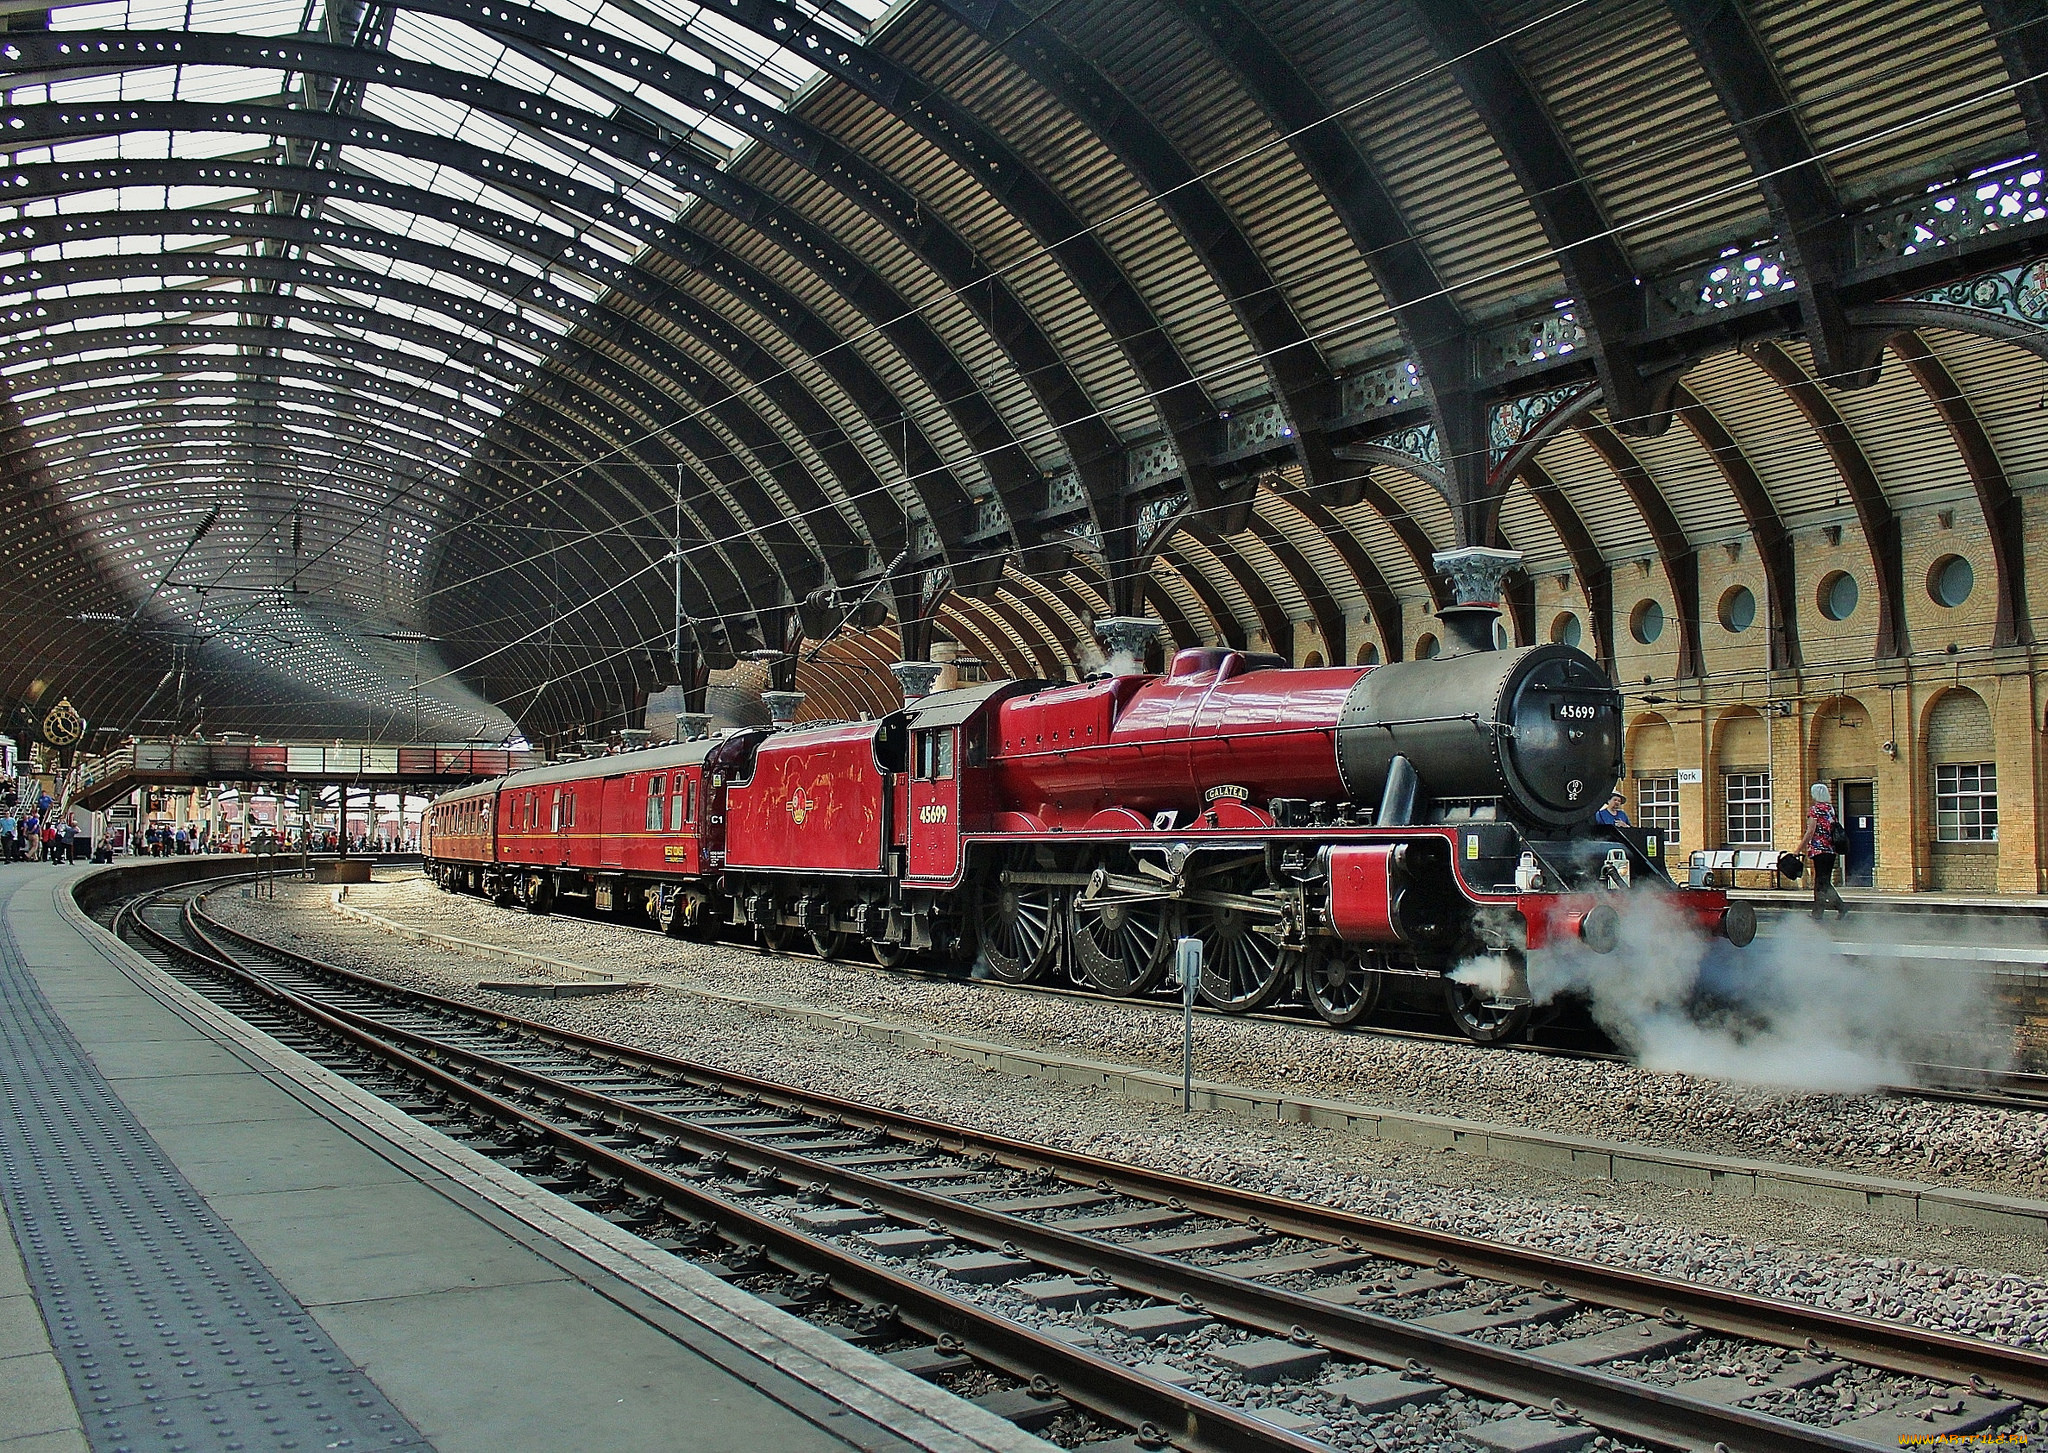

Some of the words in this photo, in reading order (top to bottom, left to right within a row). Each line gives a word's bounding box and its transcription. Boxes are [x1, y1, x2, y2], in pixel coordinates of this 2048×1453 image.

[1560, 705, 1595, 719] 45699
[1679, 771, 1696, 781] York
[1209, 786, 1243, 799] GALATEA
[711, 815, 723, 824] C1
[919, 805, 947, 824] 45699
